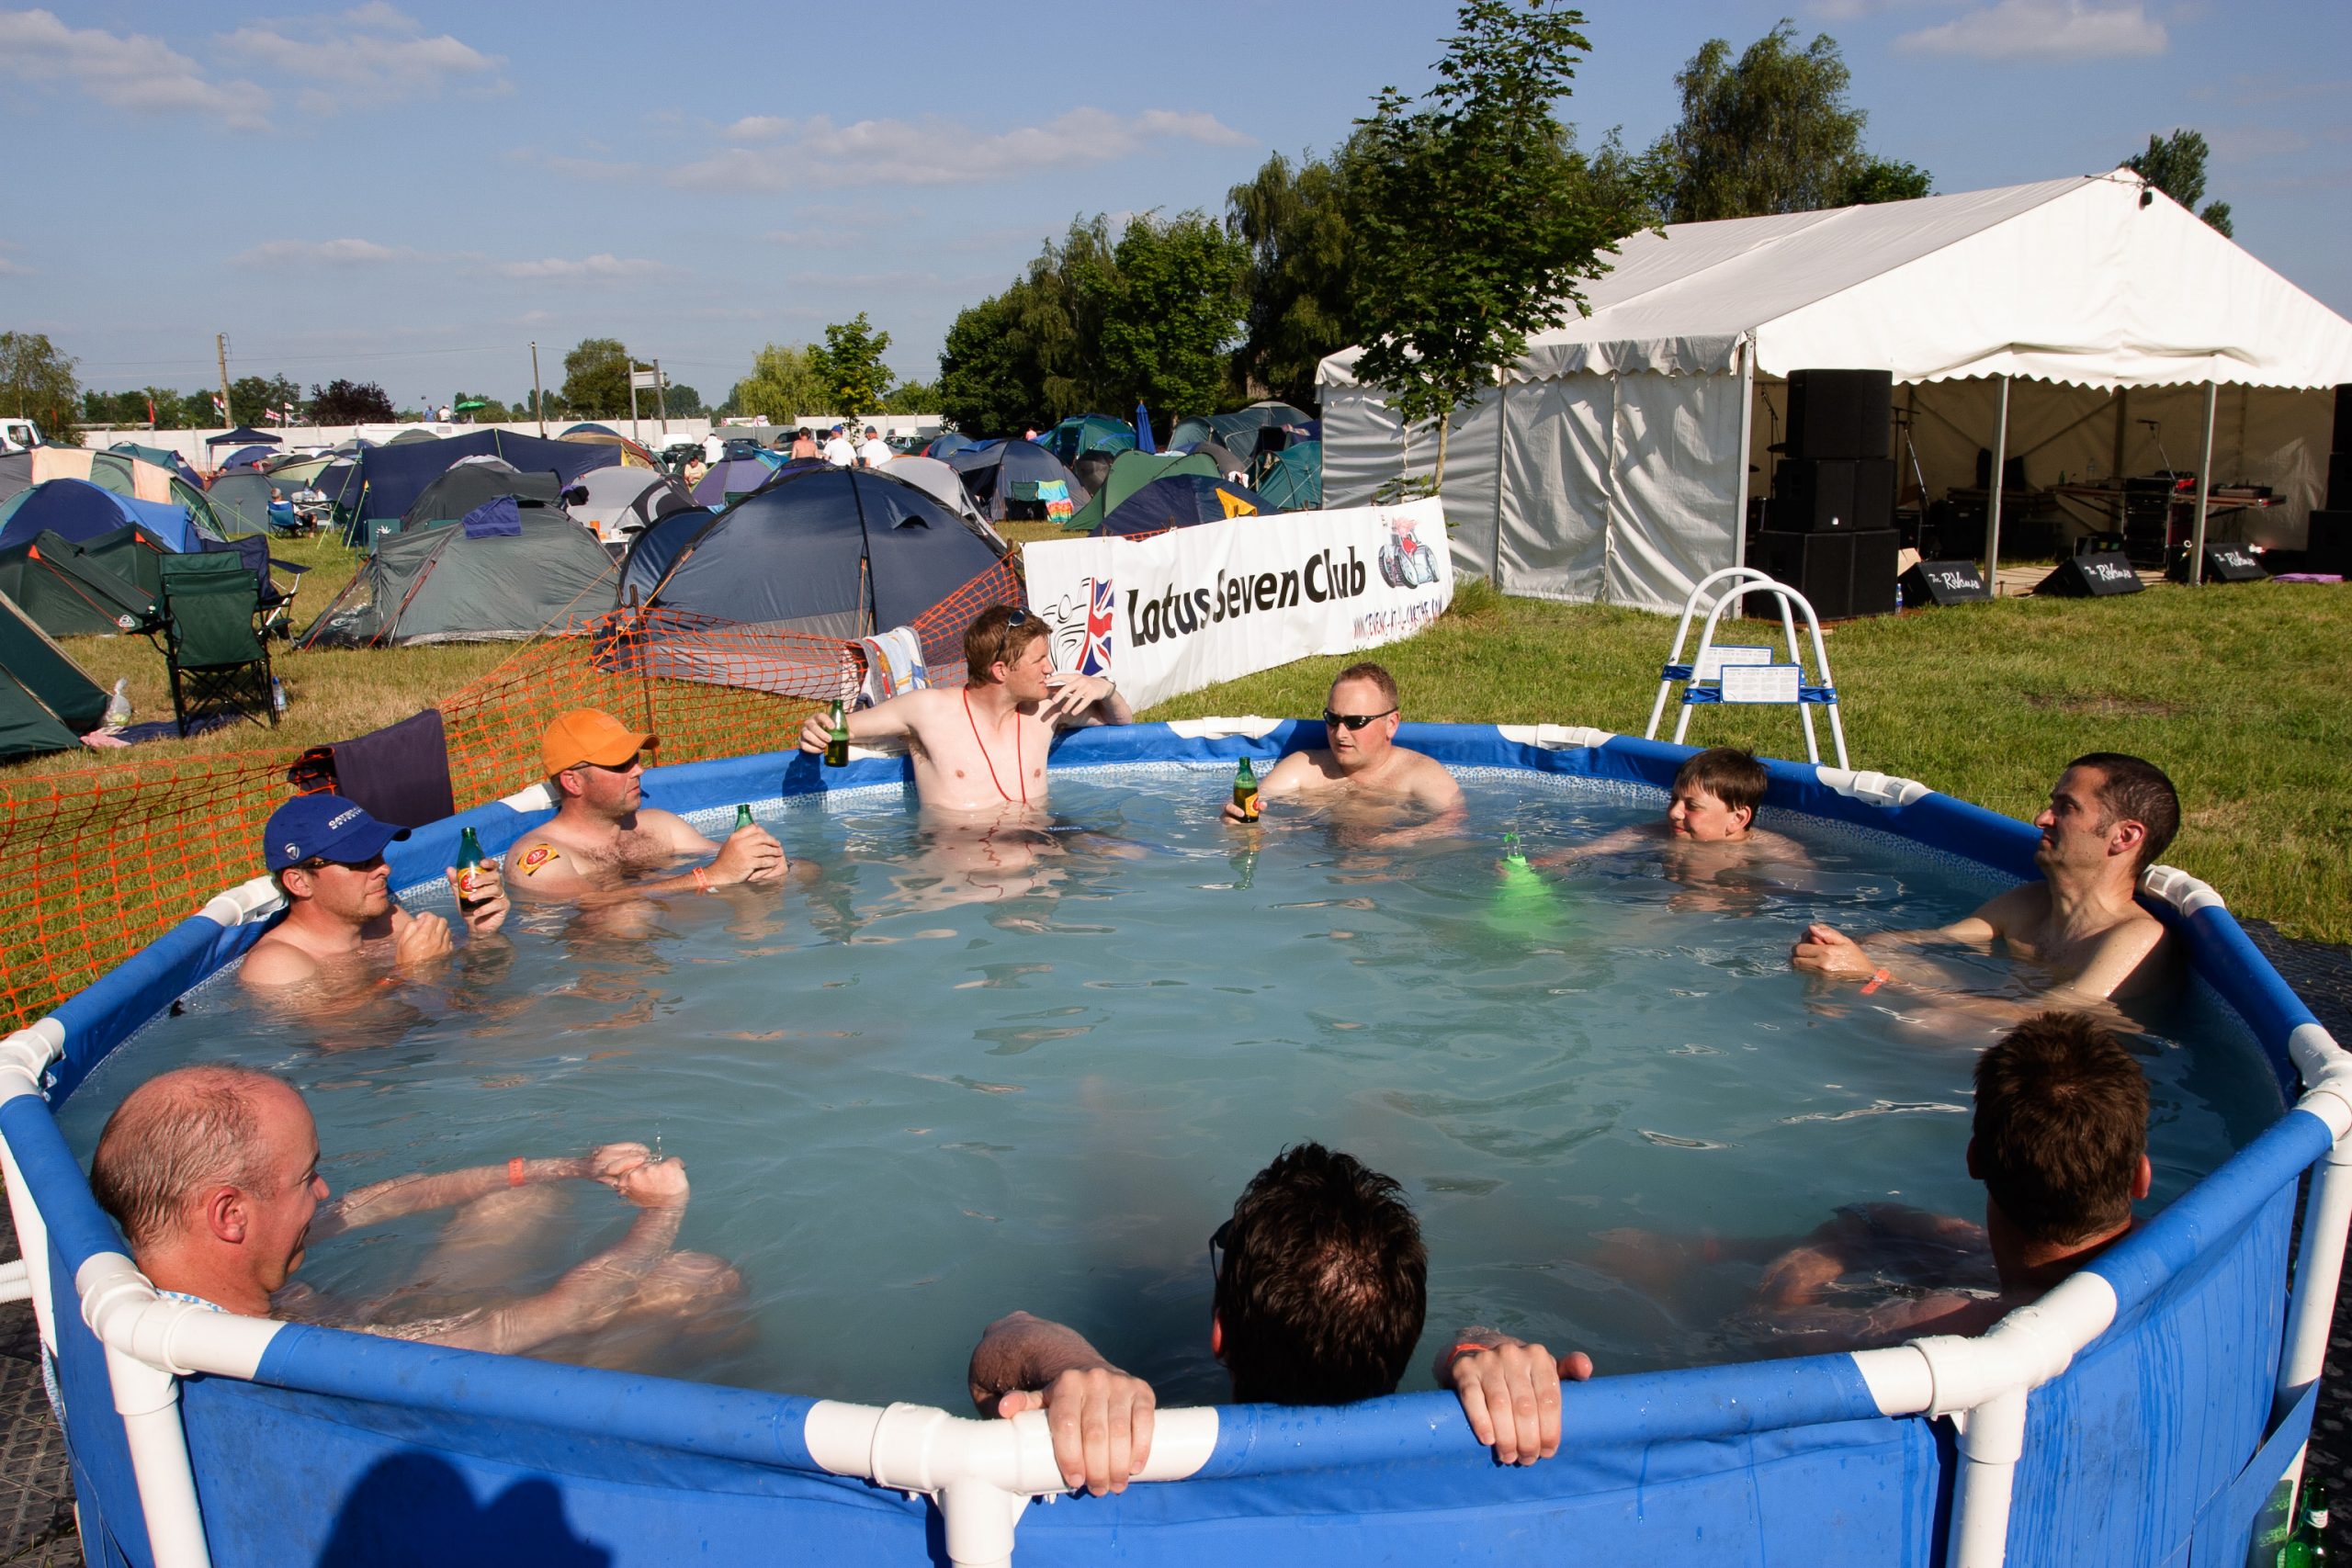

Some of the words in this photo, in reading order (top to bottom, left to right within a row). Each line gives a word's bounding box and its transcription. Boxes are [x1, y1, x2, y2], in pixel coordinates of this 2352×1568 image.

[1125, 582, 1210, 648] Lotus
[1213, 569, 1300, 624] Seven
[1304, 546, 1366, 604] Club
